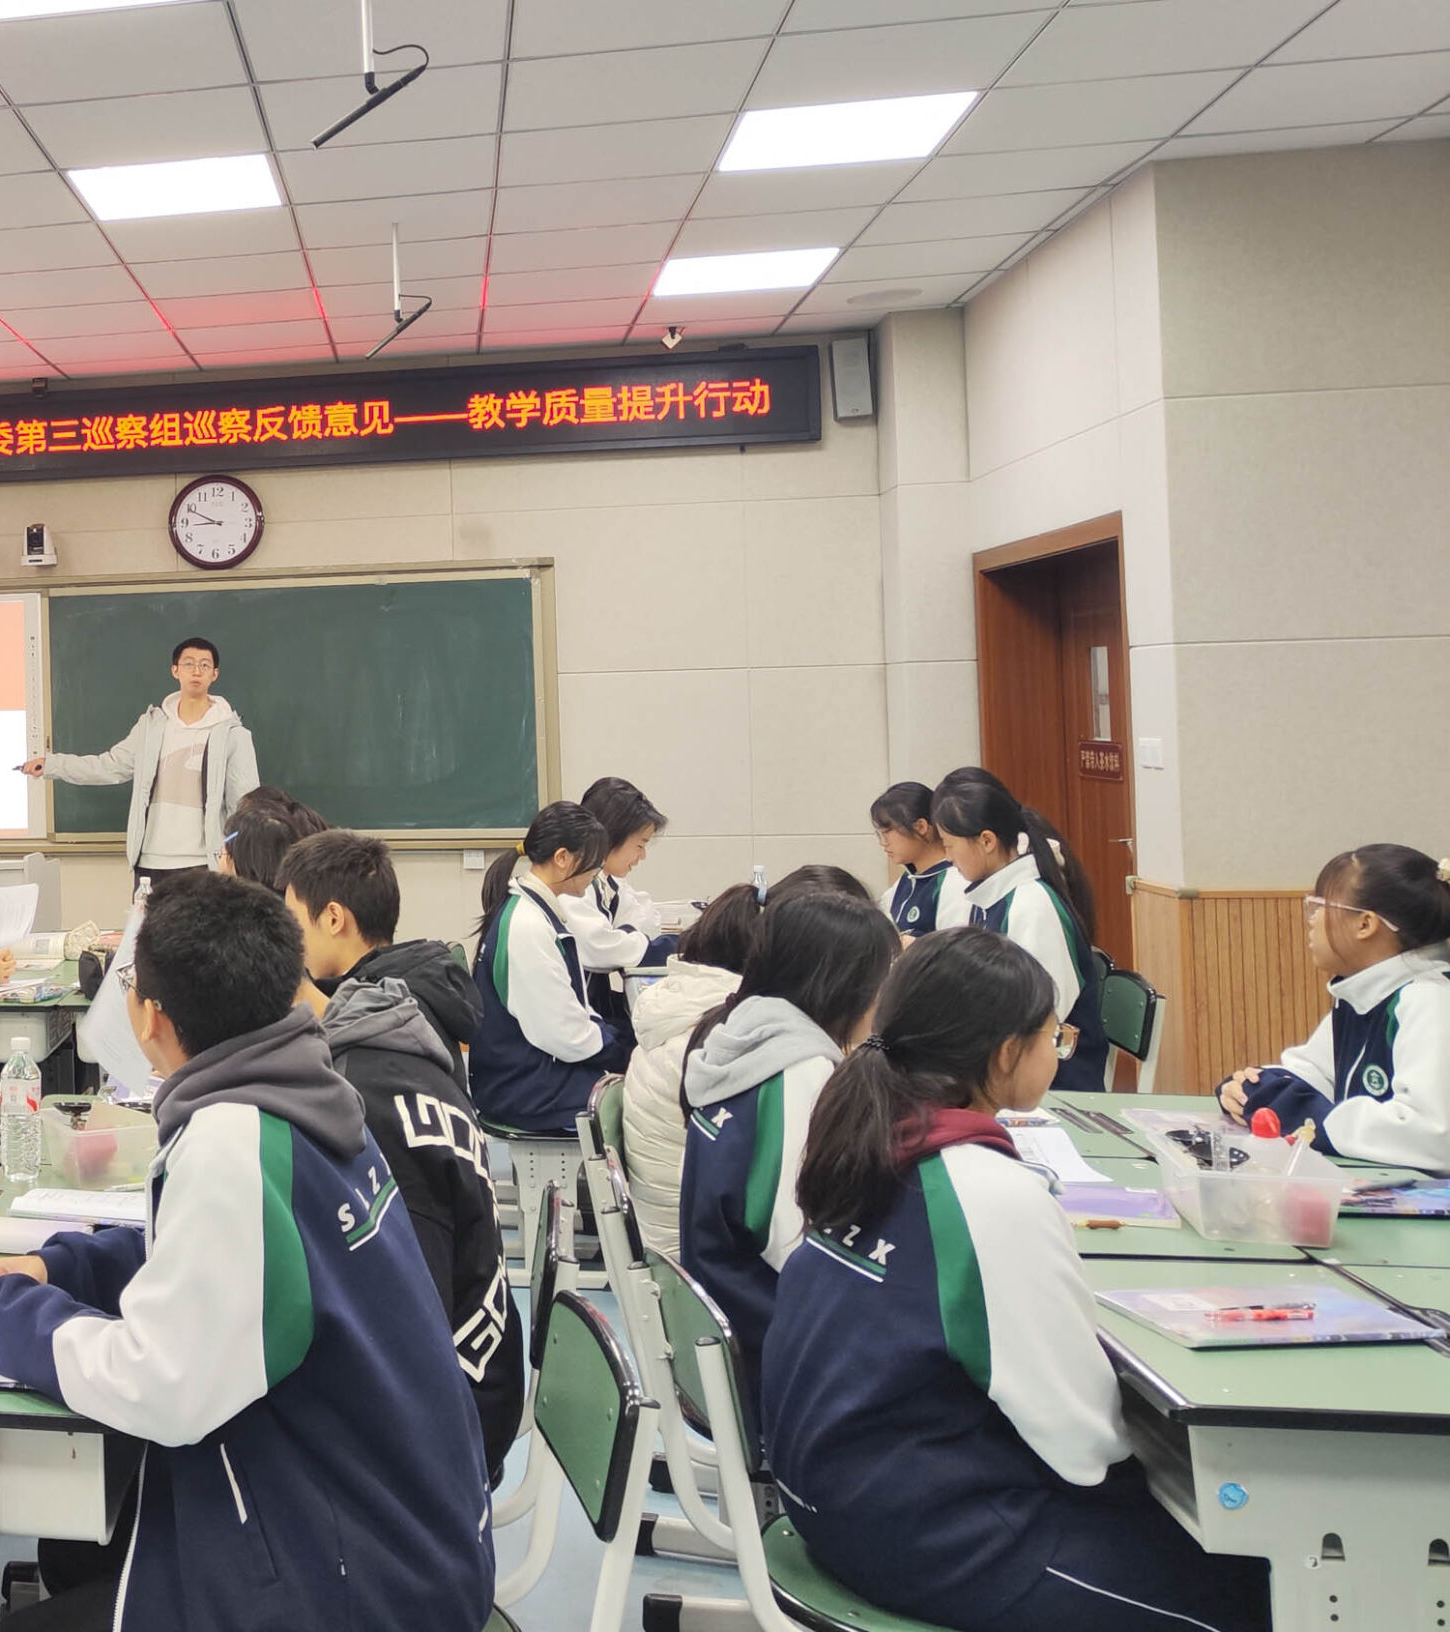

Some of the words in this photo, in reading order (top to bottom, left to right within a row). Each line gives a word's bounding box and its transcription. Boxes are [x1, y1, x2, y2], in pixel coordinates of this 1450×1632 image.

[198, 492, 207, 502] 11
[211, 487, 224, 497] 12
[231, 491, 235, 502] 1
[187, 503, 197, 513] 10
[241, 503, 248, 512] 2
[181, 518, 189, 528] 9
[244, 518, 253, 528] 3
[185, 533, 193, 543] 8
[240, 532, 247, 543] 4
[197, 544, 205, 555] 7
[211, 548, 220, 559] 6
[228, 544, 235, 555] 5
